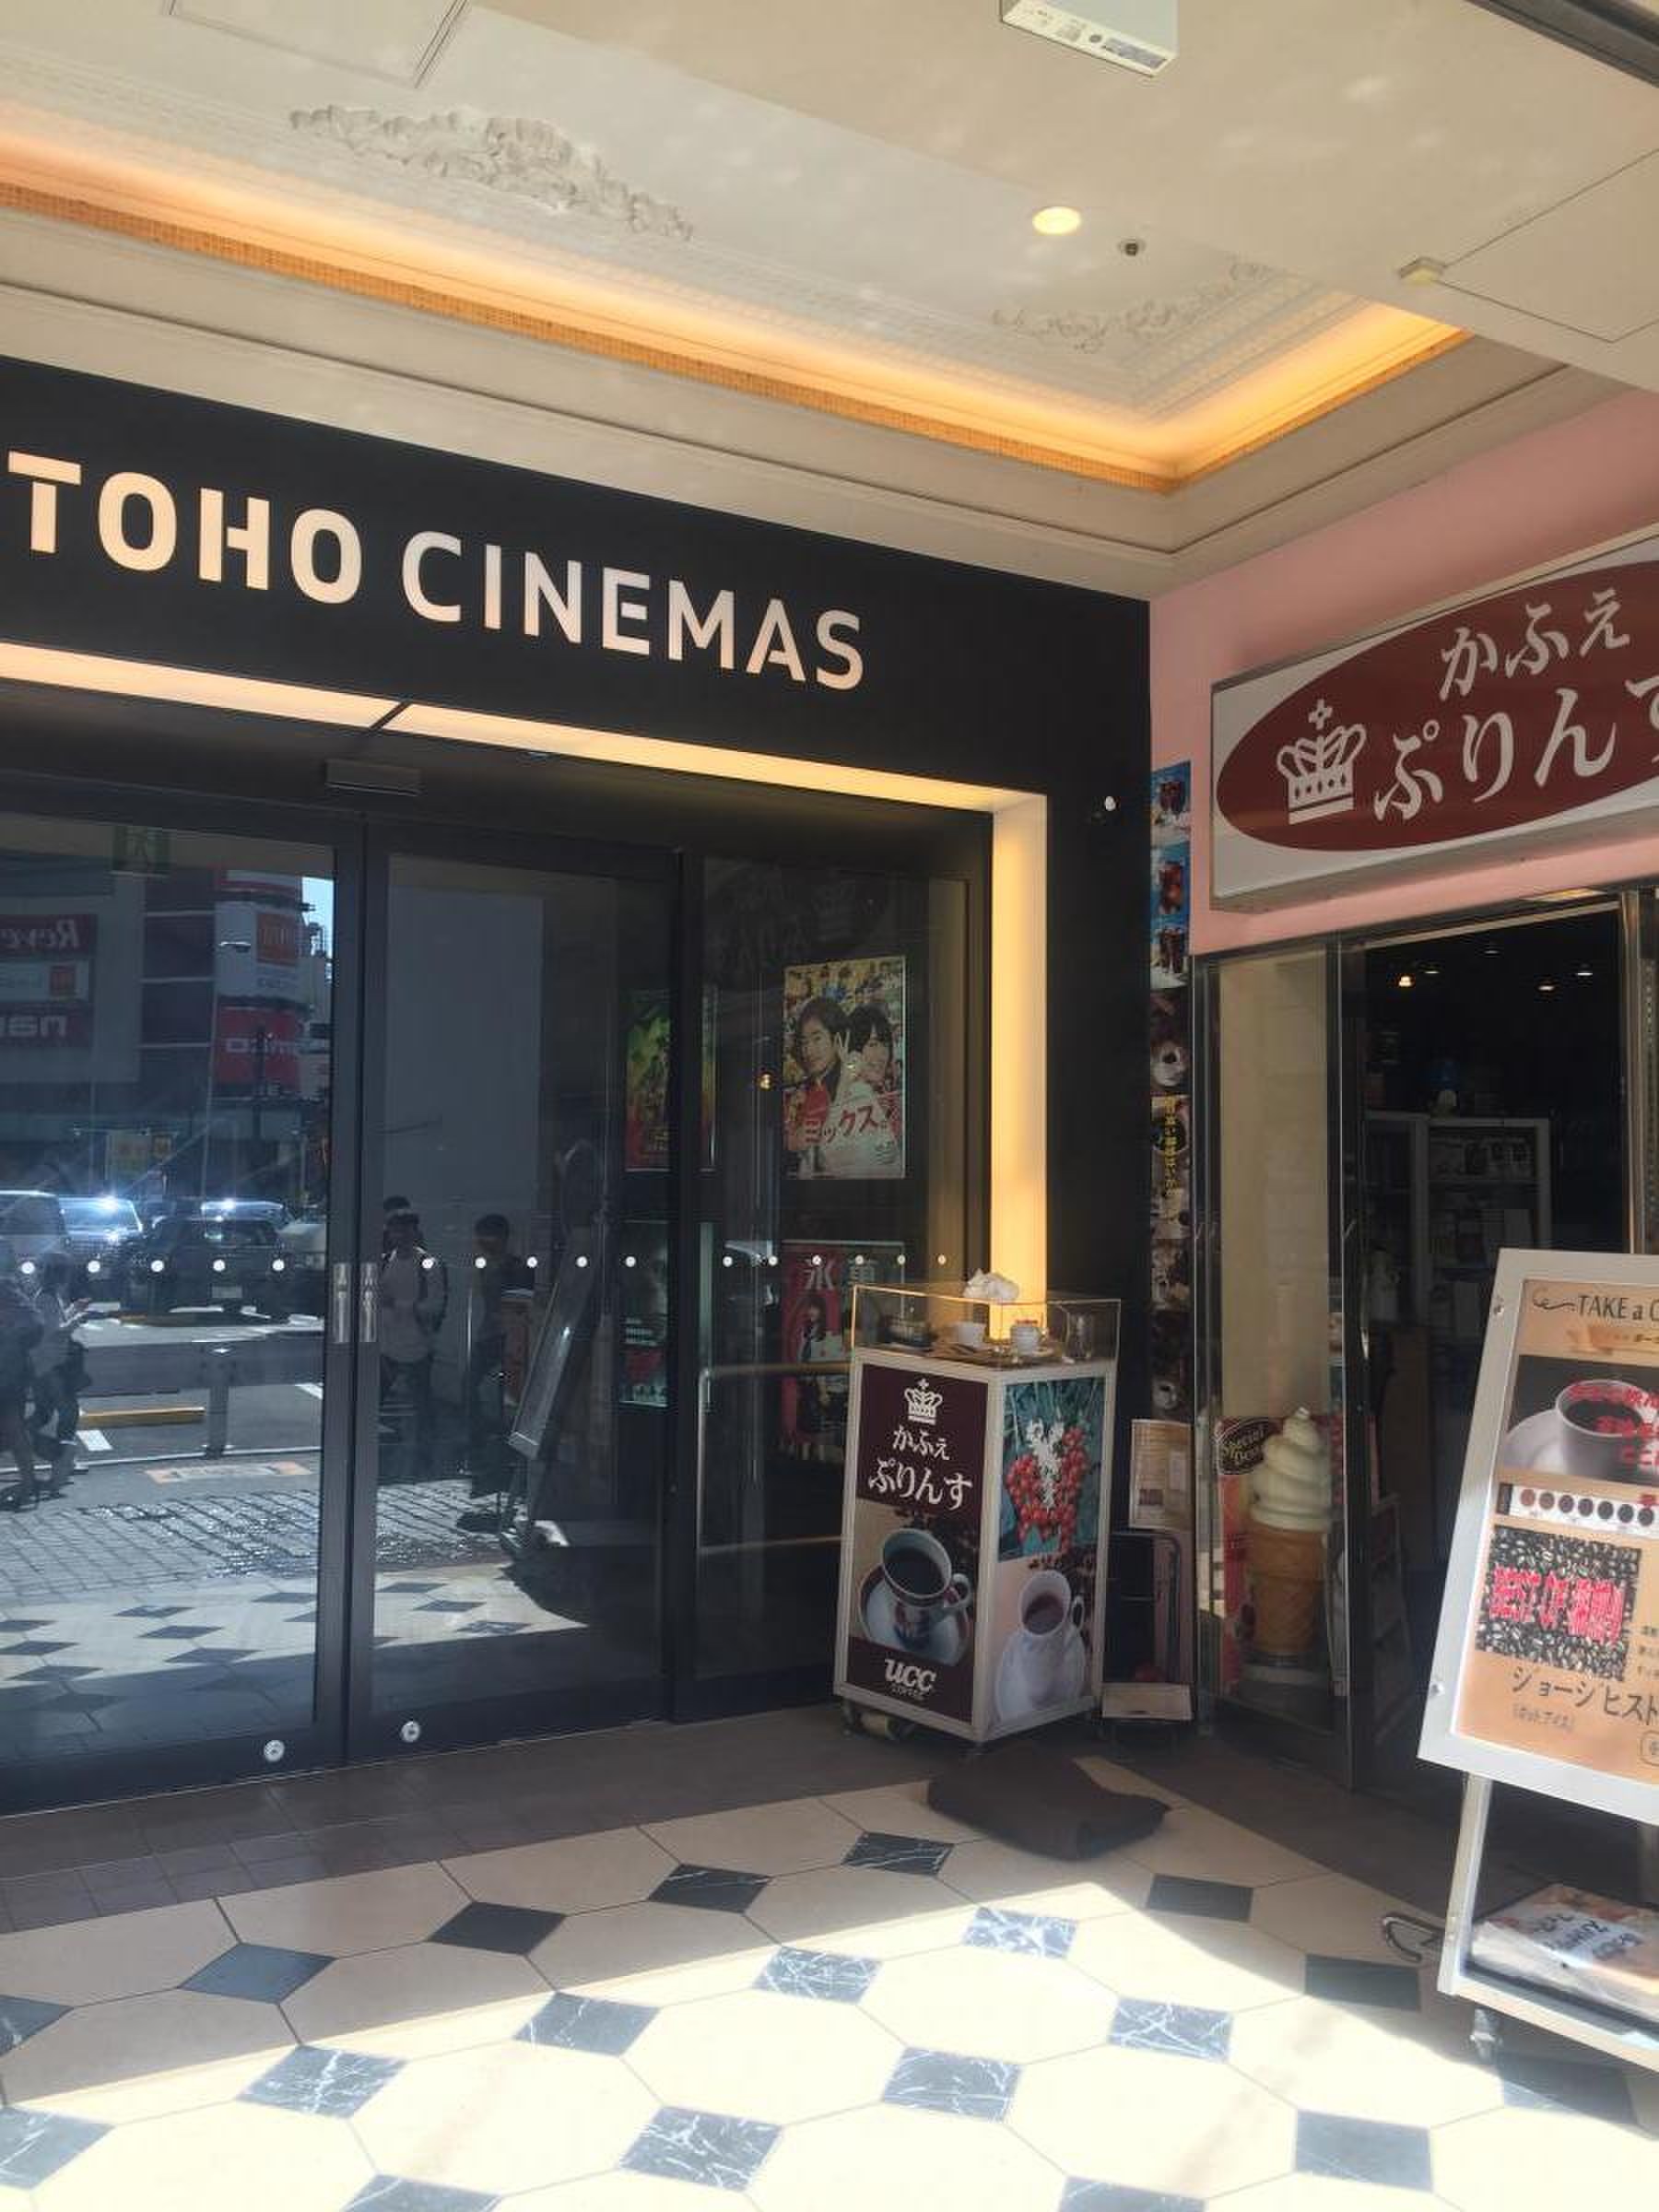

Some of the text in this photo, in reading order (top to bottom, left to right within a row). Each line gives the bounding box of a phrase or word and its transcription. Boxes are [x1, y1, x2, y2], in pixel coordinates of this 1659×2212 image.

[8, 450, 864, 690] TOHO CINEMAS
[1577, 1295, 1628, 1320] TAKE
[1632, 1304, 1643, 1320] a
[868, 1457, 973, 1511] ぷりんす
